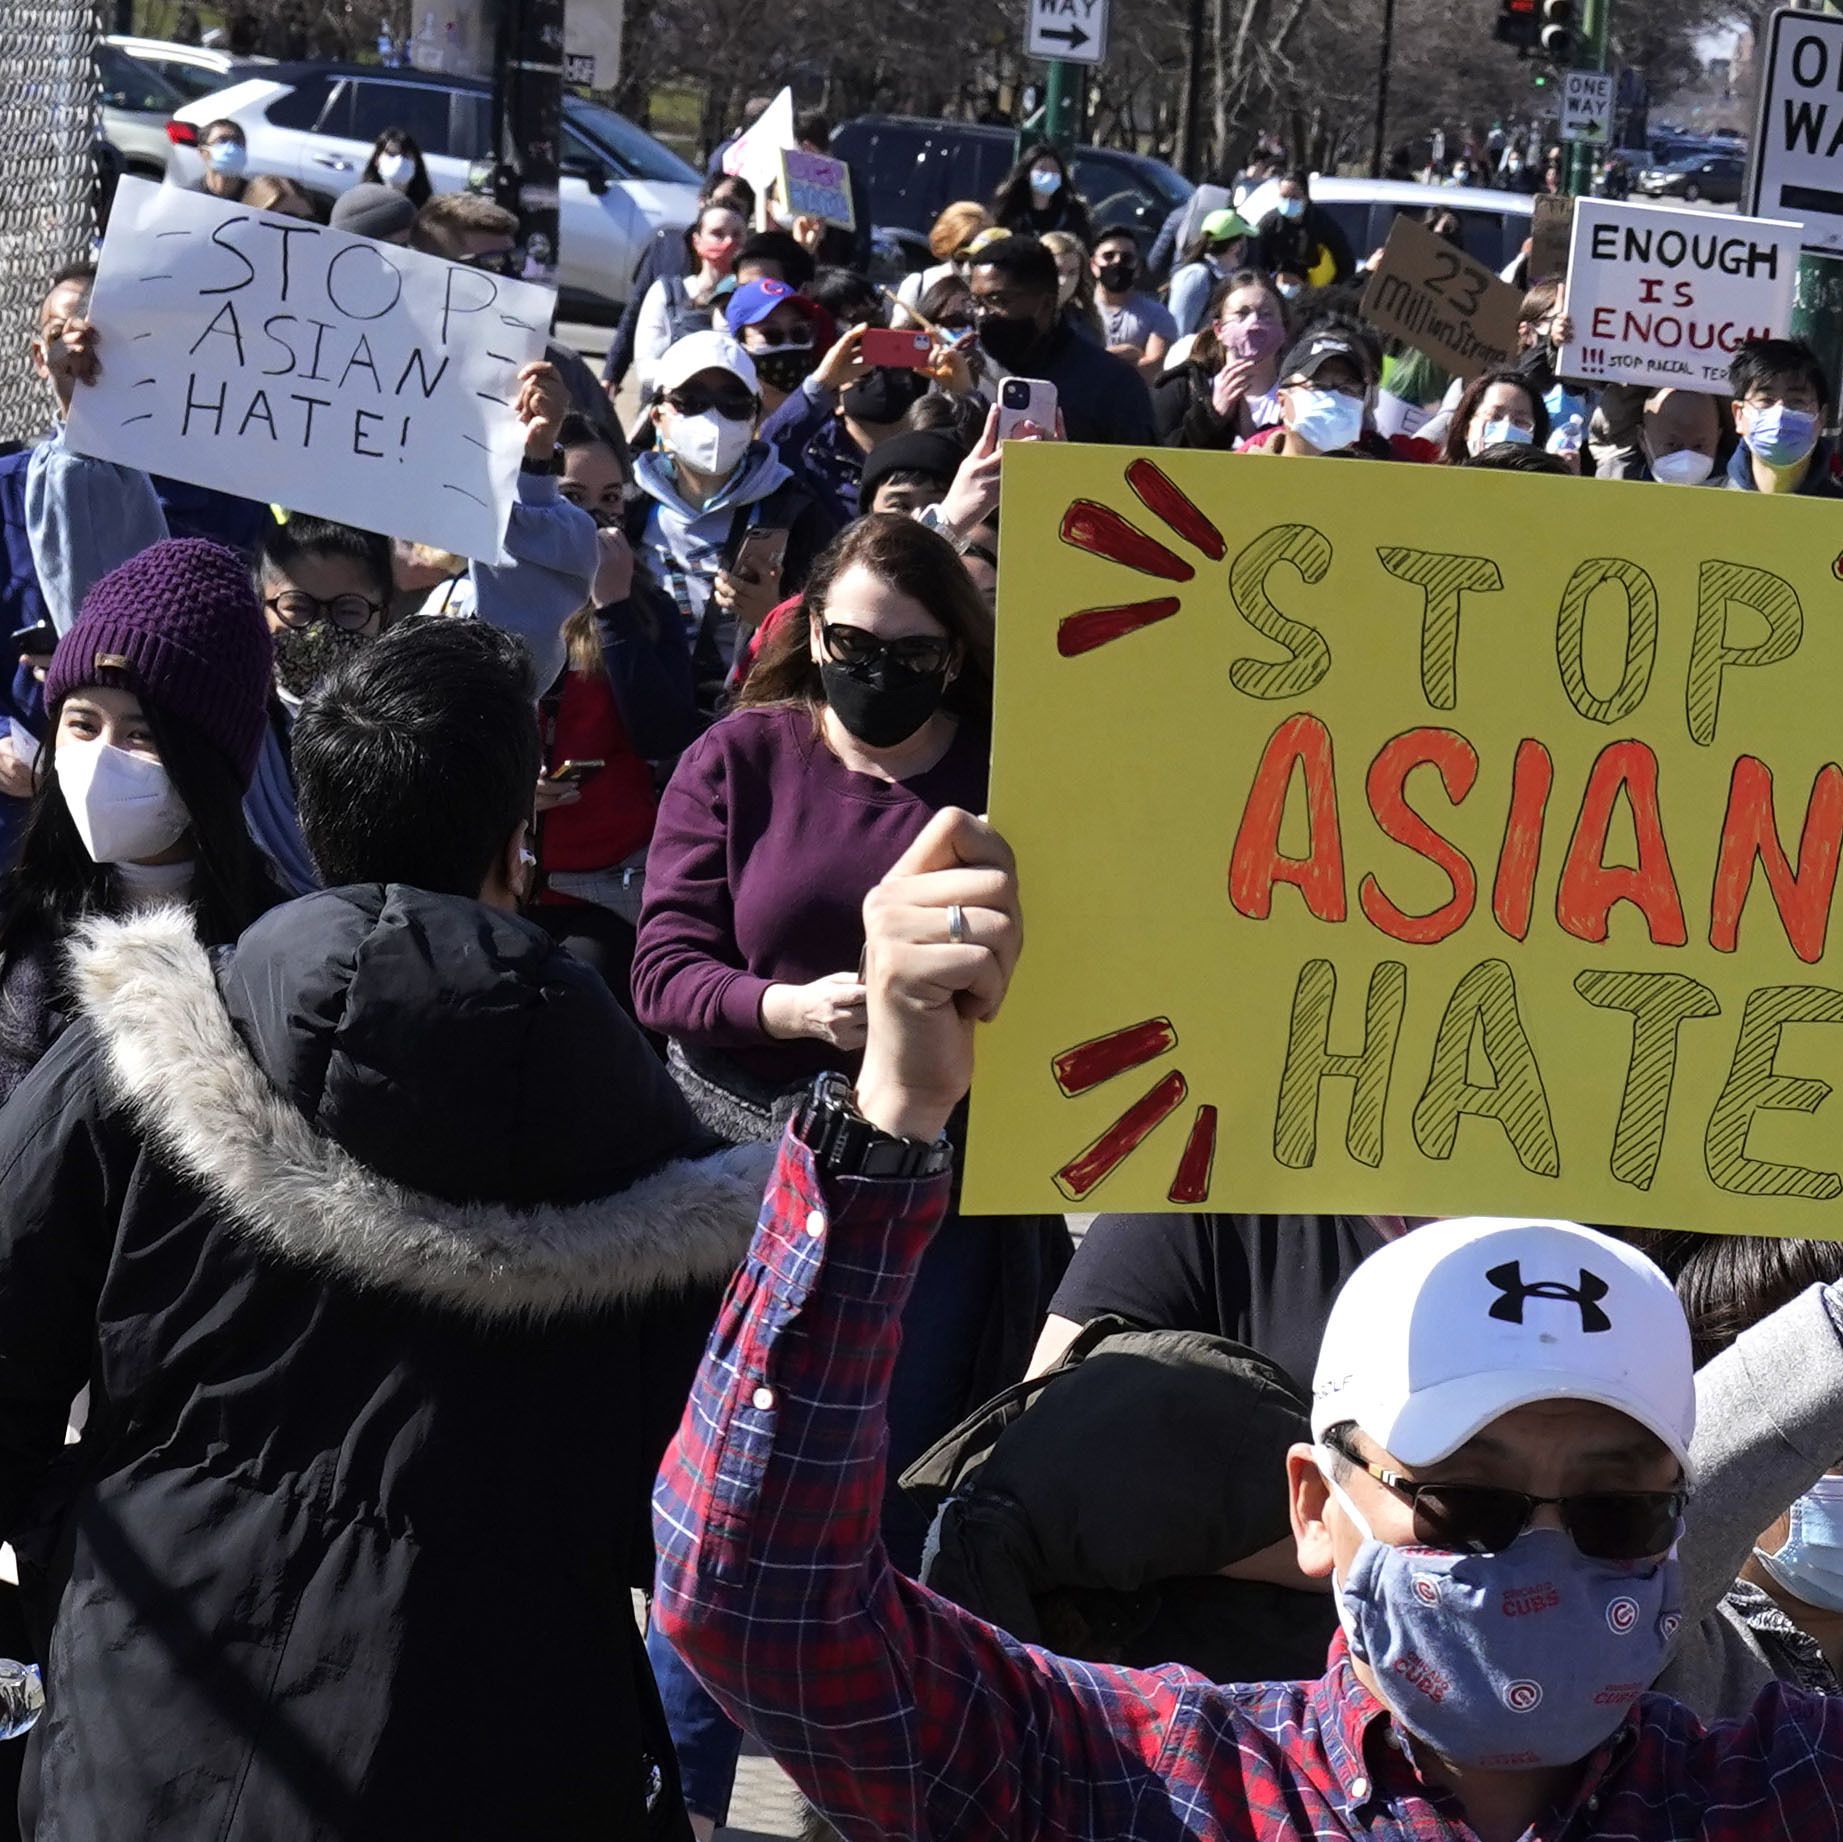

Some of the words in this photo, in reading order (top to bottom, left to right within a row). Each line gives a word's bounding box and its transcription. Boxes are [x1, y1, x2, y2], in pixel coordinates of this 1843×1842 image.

[1567, 97, 1607, 116] WAY
[1569, 77, 1608, 97] ONE
[1592, 224, 1778, 281] ENOUGH
[200, 216, 498, 345] STOP
[1424, 251, 1489, 317] 23
[1639, 278, 1694, 307] IS
[189, 301, 450, 399] ASIAN
[1592, 308, 1771, 353] ENOUGH
[1607, 355, 1643, 368] STOP
[181, 374, 410, 464] HATE!
[1227, 522, 1804, 747] STOP
[1501, 1593, 1561, 1618] CUBS
[1393, 1658, 1445, 1704] CUBS
